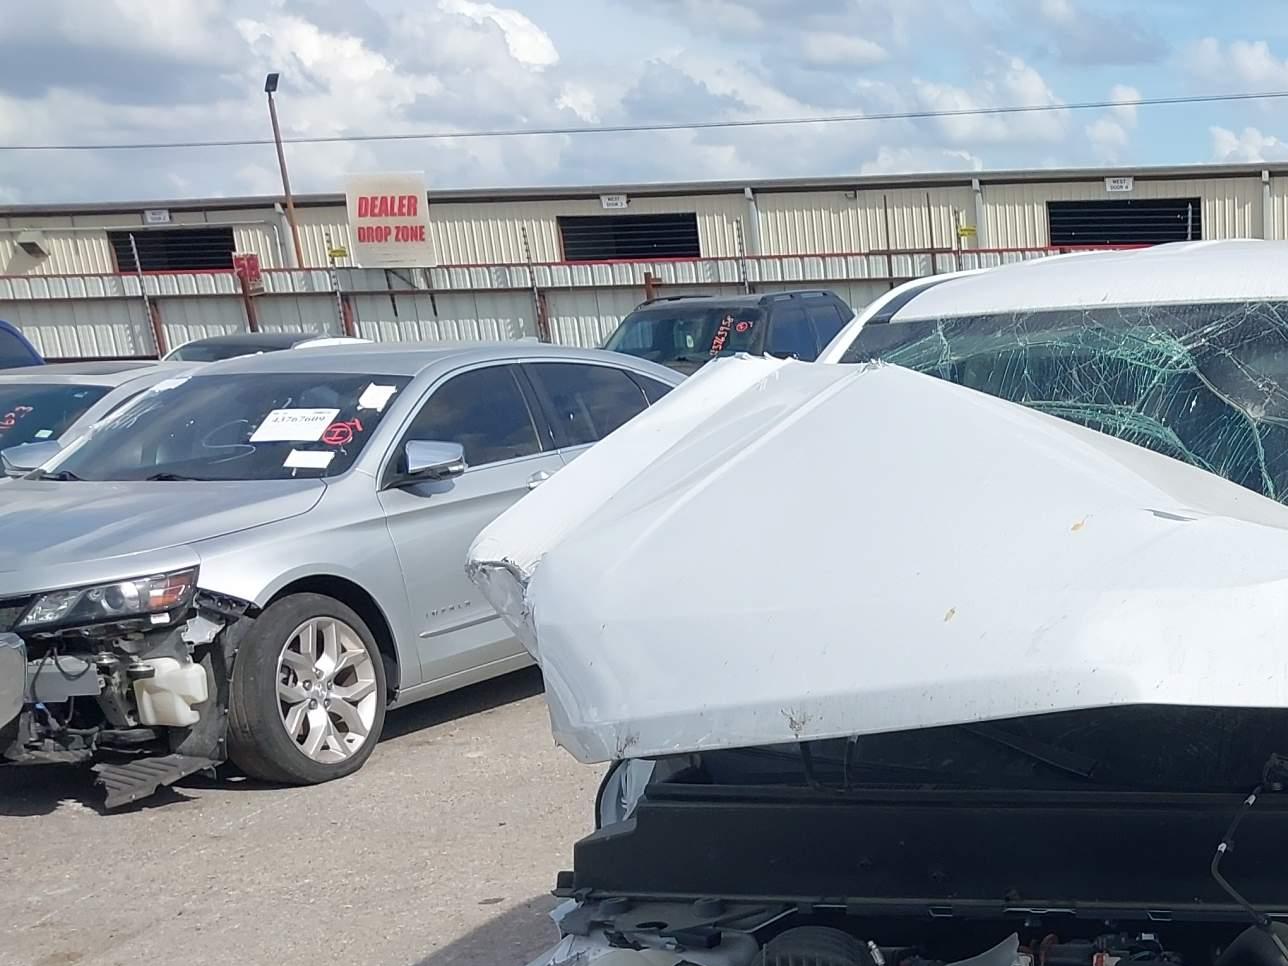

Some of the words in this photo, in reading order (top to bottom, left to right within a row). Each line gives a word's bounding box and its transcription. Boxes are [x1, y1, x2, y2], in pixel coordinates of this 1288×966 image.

[358, 196, 417, 217] DEALER
[358, 226, 391, 243] DROP
[394, 225, 426, 242] ZONE
